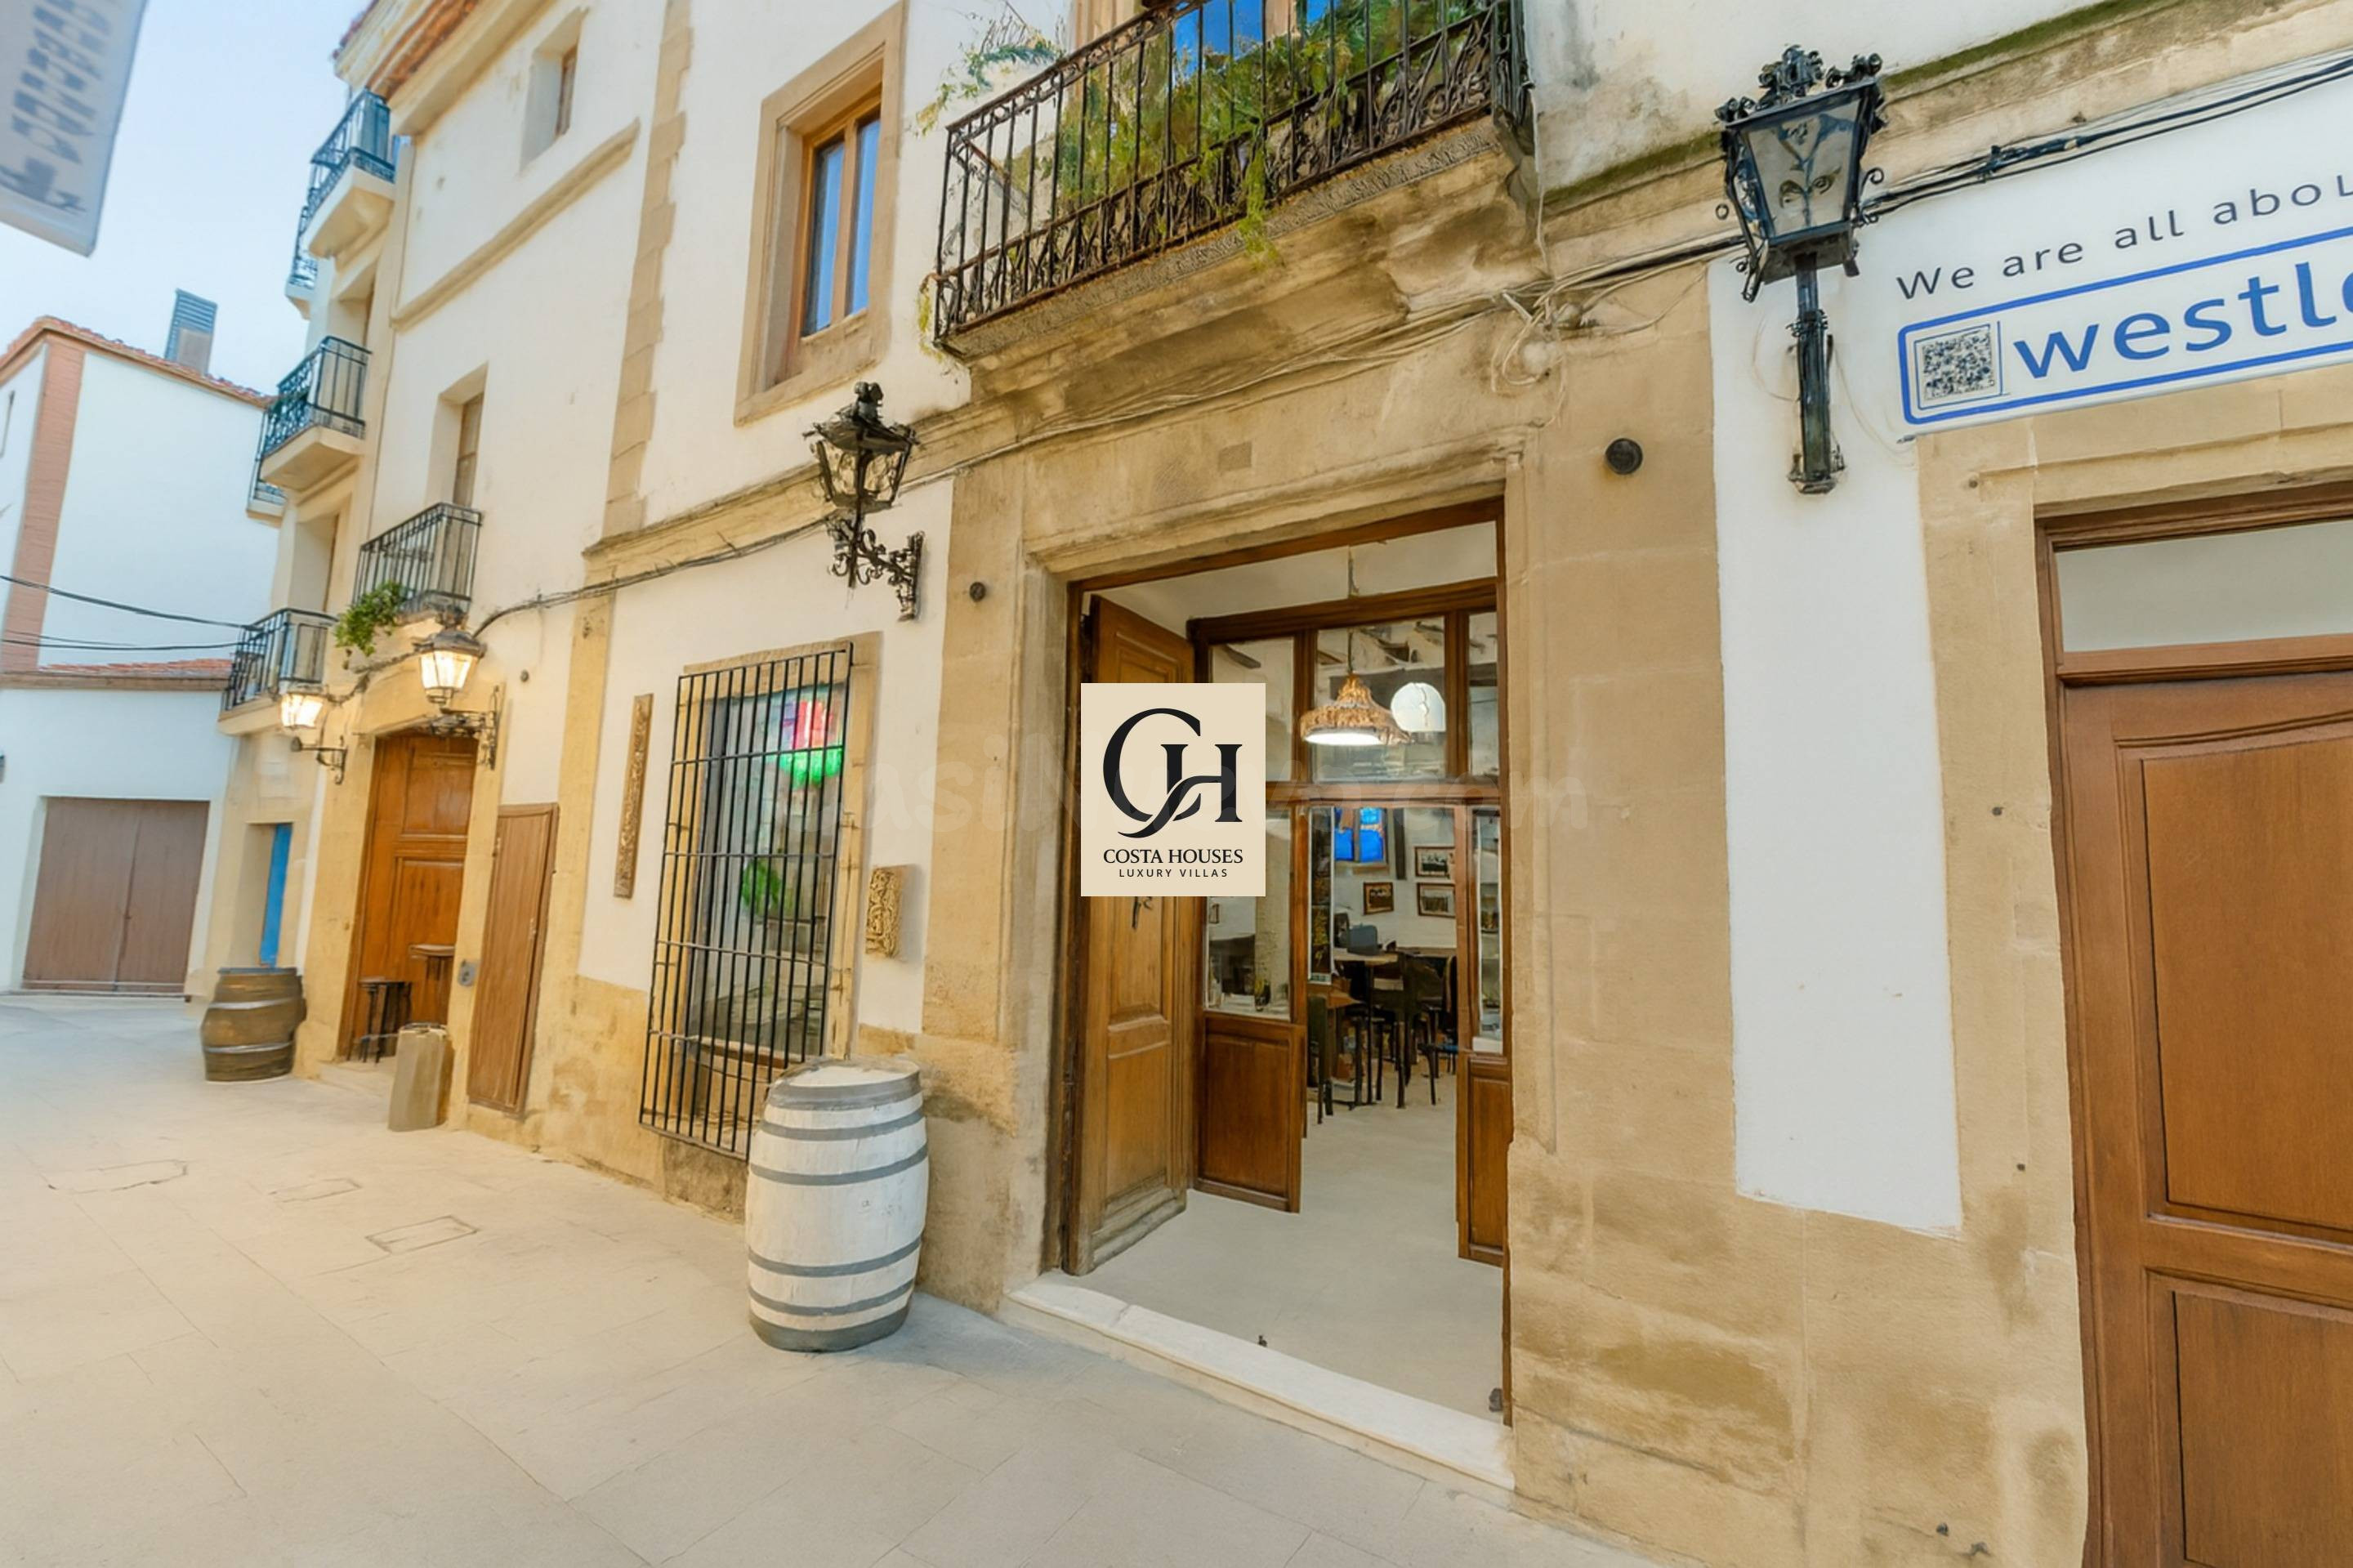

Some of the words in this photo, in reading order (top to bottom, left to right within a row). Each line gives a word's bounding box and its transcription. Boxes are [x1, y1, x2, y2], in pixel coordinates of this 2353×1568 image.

[1895, 266, 1975, 300] We
[2002, 241, 2083, 277] are
[2114, 209, 2185, 249] all
[2012, 261, 2353, 379] westl
